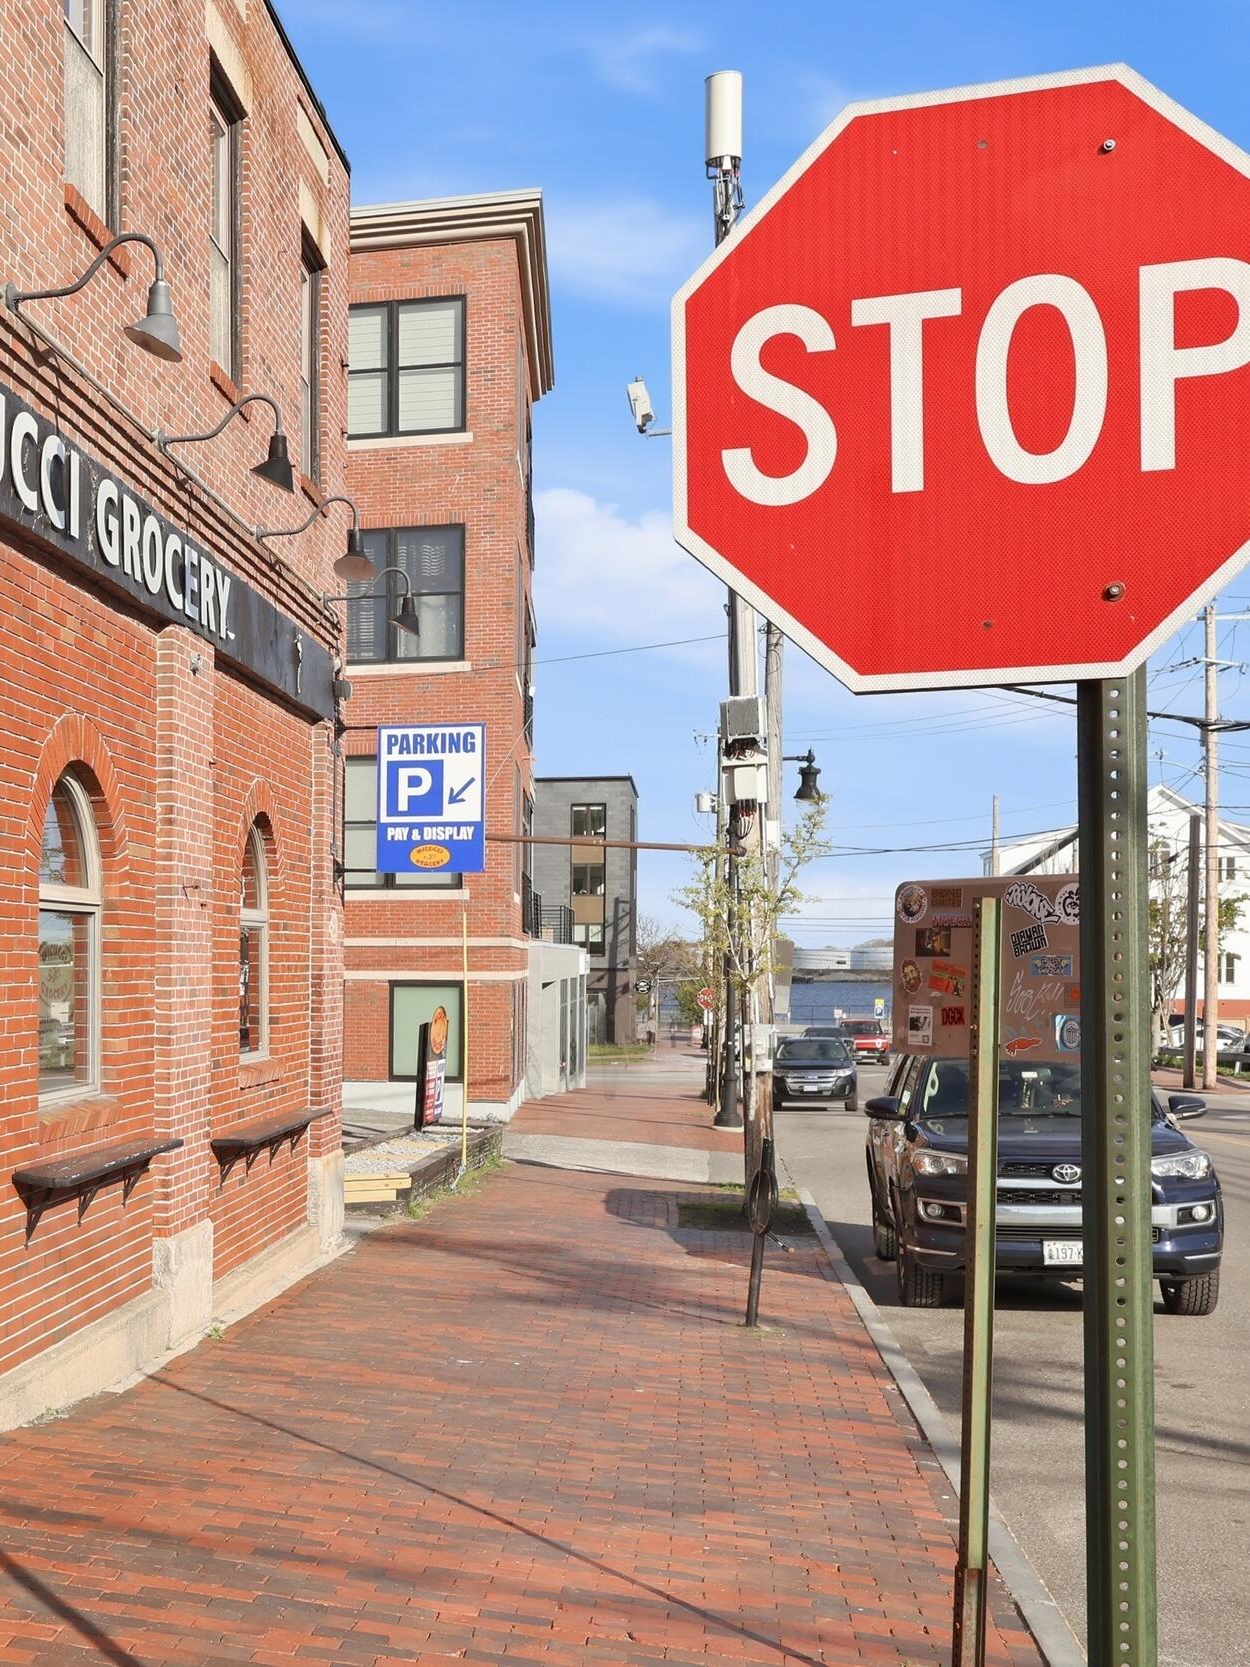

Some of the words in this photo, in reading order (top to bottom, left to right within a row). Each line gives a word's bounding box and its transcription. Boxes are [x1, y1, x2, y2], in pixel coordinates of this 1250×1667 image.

[721, 256, 1250, 507] STOP
[96, 479, 232, 640] GROCERY
[386, 731, 476, 755] PARKING
[397, 767, 433, 812] P
[387, 827, 410, 841] PAY
[411, 827, 421, 841] &
[423, 826, 475, 841] DISPLAY
